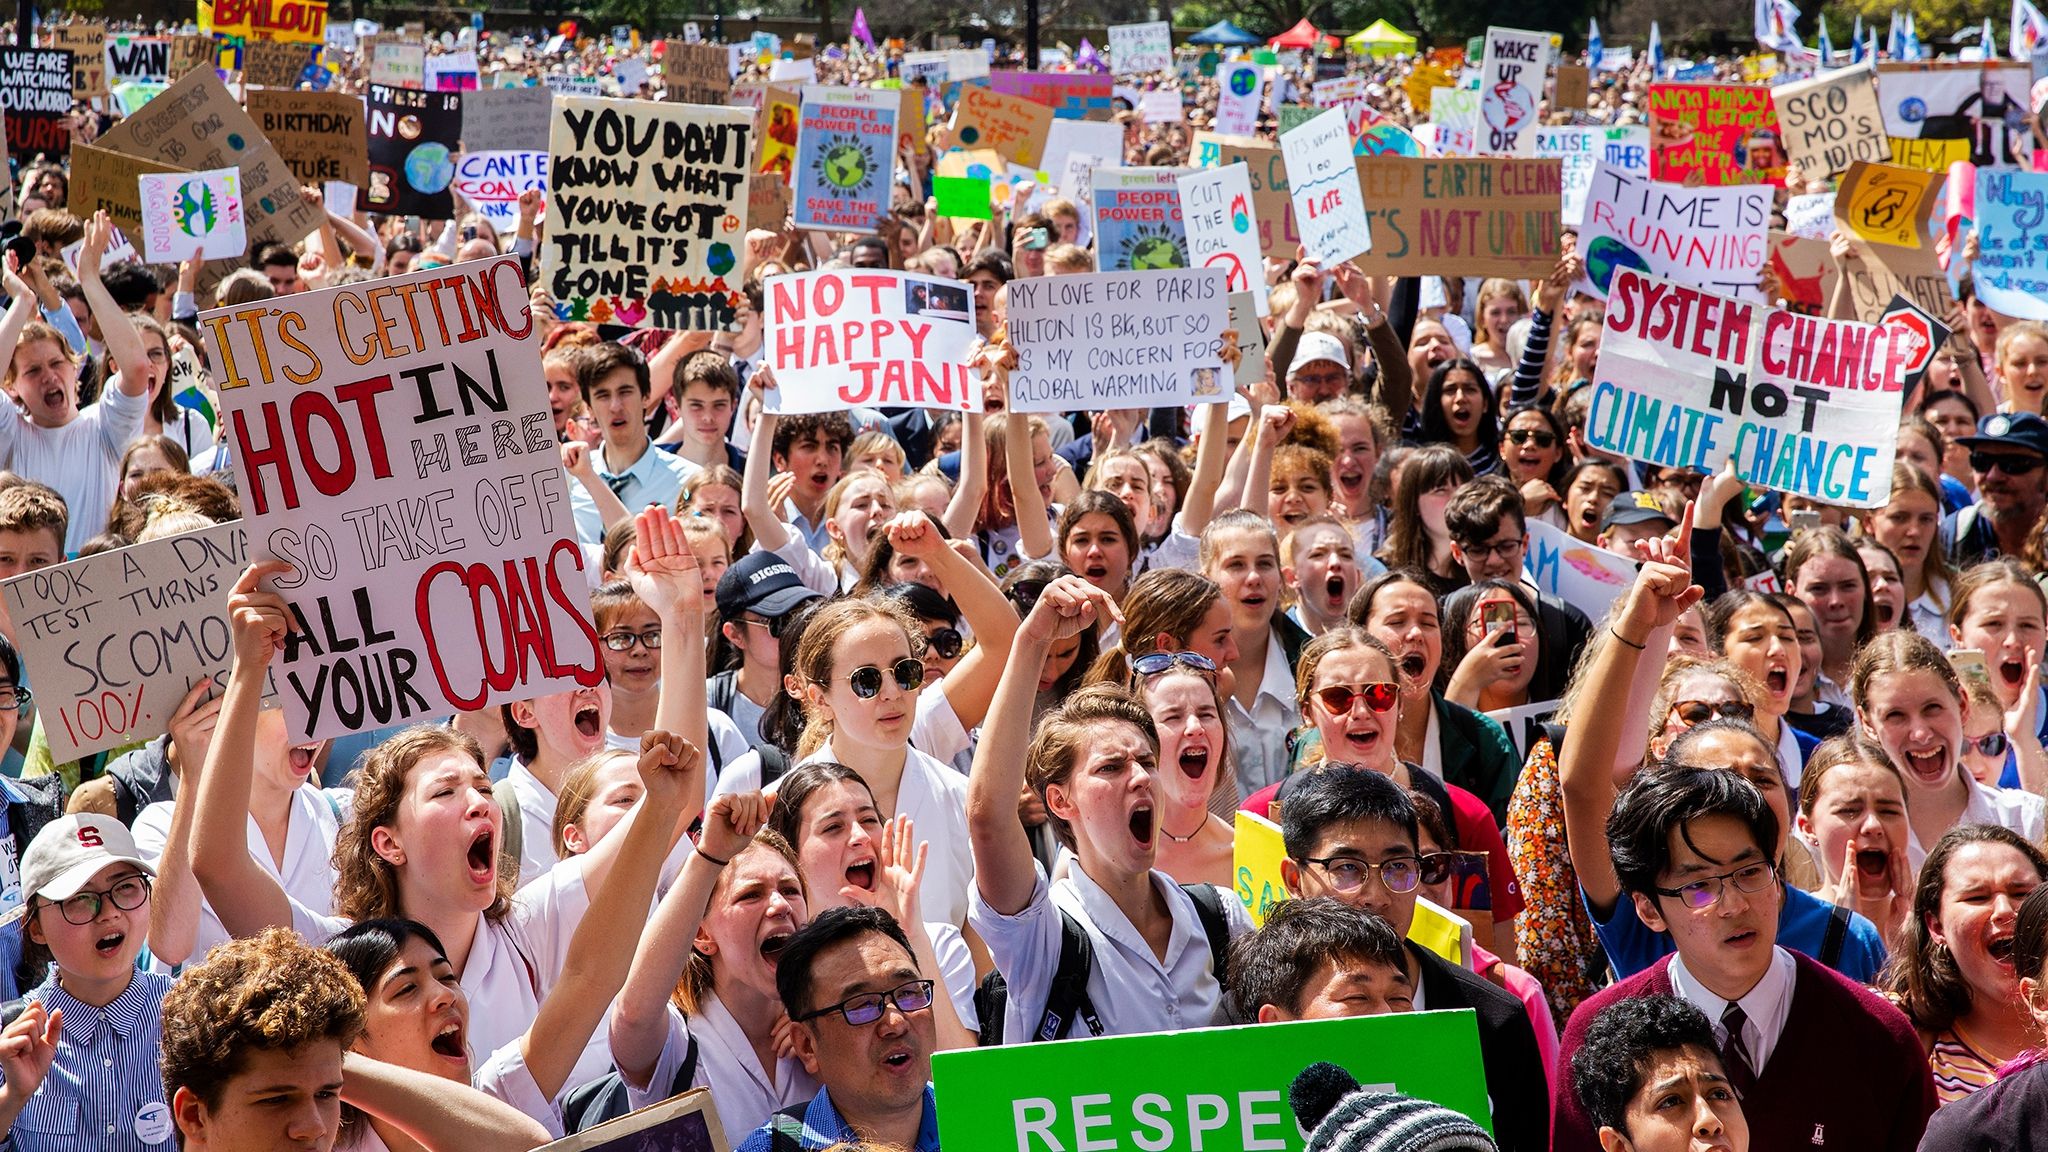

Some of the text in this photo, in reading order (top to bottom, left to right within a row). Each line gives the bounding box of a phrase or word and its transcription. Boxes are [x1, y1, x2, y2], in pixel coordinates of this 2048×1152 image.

[214, 0, 326, 36] BAILOUT
[4, 51, 68, 69] WE ARE
[1493, 40, 1539, 63] WAKE
[0, 69, 72, 90] WATCHING
[1499, 64, 1522, 83] UP
[0, 87, 34, 111] OUR
[129, 83, 212, 149] GREATEST
[820, 104, 878, 121] PEOPLE
[1787, 85, 1849, 127] SCO
[159, 138, 187, 162] TO
[191, 112, 226, 145] OUR
[263, 112, 352, 136] BIRTHDAY
[563, 108, 660, 159] YOU
[662, 120, 751, 169] DON'T
[803, 117, 893, 136] POWER CAN
[1490, 130, 1518, 151] OR
[1536, 133, 1592, 151] RAISE
[552, 155, 640, 192] KNOW
[652, 162, 745, 201] WHAT
[1120, 173, 1155, 187] green
[1190, 181, 1223, 207] CUT
[1423, 162, 1492, 198] EARTH
[1500, 162, 1562, 196] CLEAN
[554, 193, 727, 240] YOU'VE GOT
[807, 198, 878, 214] SAVE THE
[1098, 207, 1164, 222] POWER
[1117, 191, 1181, 206] PEOPL
[1307, 188, 1342, 220] LATE
[1604, 168, 1720, 229] TIME
[1736, 194, 1764, 229] IS
[1986, 172, 2045, 230] Why
[812, 211, 870, 226] PLANET
[1192, 210, 1224, 233] THE
[1366, 207, 1409, 259] T'S
[1420, 207, 1482, 257] NOT
[552, 233, 689, 267] TILL IT'S
[1195, 239, 1229, 255] COAL
[553, 263, 649, 300] GONE
[773, 274, 898, 325] NOT
[1010, 276, 1216, 309] MY LOVE FOR PARIS
[203, 259, 534, 391] IT'S GETTING
[1009, 315, 1075, 347] HILTON
[1085, 311, 1105, 340] IS
[1183, 312, 1212, 337] SO
[1607, 271, 1910, 393] SYSTEM CHANGE
[776, 319, 933, 370] HAPPY
[1047, 348, 1073, 374] MY
[1087, 343, 1174, 371] CONCERN
[1183, 338, 1225, 362] FOR
[399, 348, 509, 425] IN
[837, 359, 972, 411] JAN!
[1014, 371, 1178, 404] GLOBAL WARMING
[1709, 365, 1831, 433] NOT
[231, 373, 394, 516] HOT
[410, 411, 553, 480] HERE
[1588, 380, 1878, 502] CLIMATE CHANGE
[267, 467, 560, 590] SO TAKE OFF
[4, 564, 94, 609] TOOK
[122, 551, 146, 583] A
[22, 573, 220, 641] TEST TURNS
[282, 538, 606, 712] ALL COALS
[63, 615, 231, 698] SCOMO
[286, 647, 432, 739] YOUR
[59, 683, 152, 748] 100%
[77, 825, 104, 848] S
[1011, 1081, 1397, 1152] RESPE
